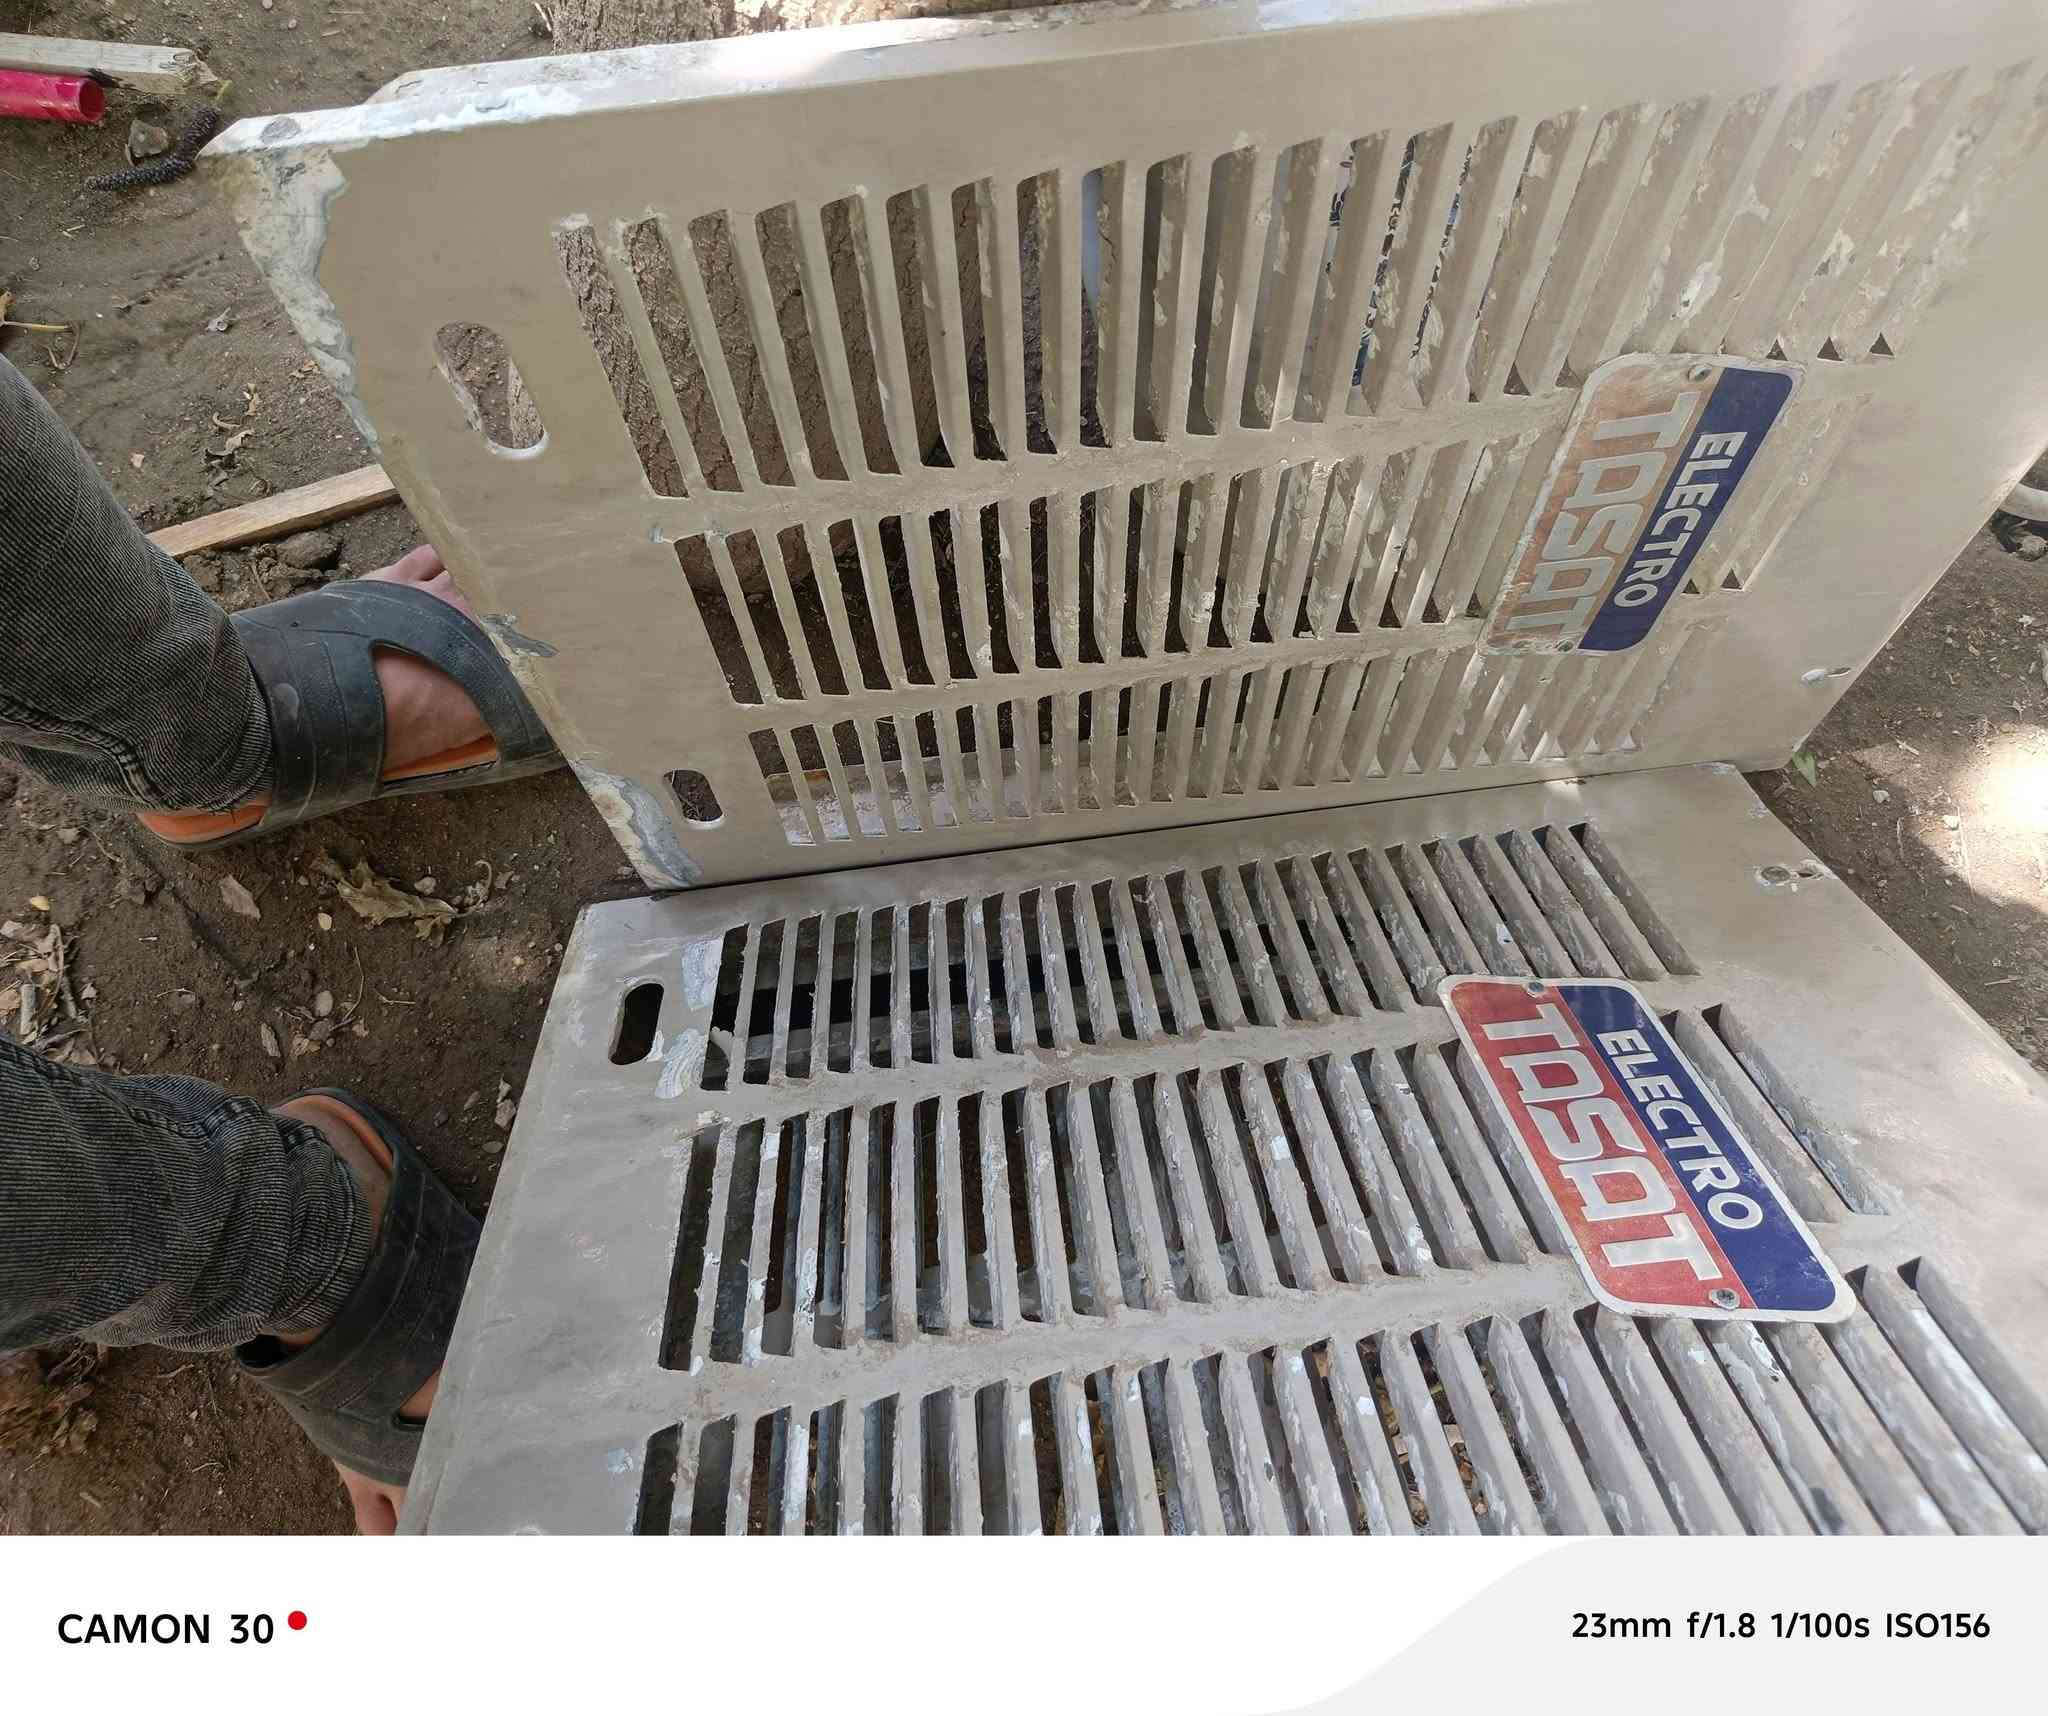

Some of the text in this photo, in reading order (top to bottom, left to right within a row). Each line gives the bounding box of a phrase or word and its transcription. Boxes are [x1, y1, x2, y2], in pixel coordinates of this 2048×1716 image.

[1504, 391, 1701, 637] TASAT
[1613, 431, 1748, 608] ELECTRO
[1481, 1003, 1723, 1281] TASAT
[1596, 1029, 1763, 1230] ELECTRO
